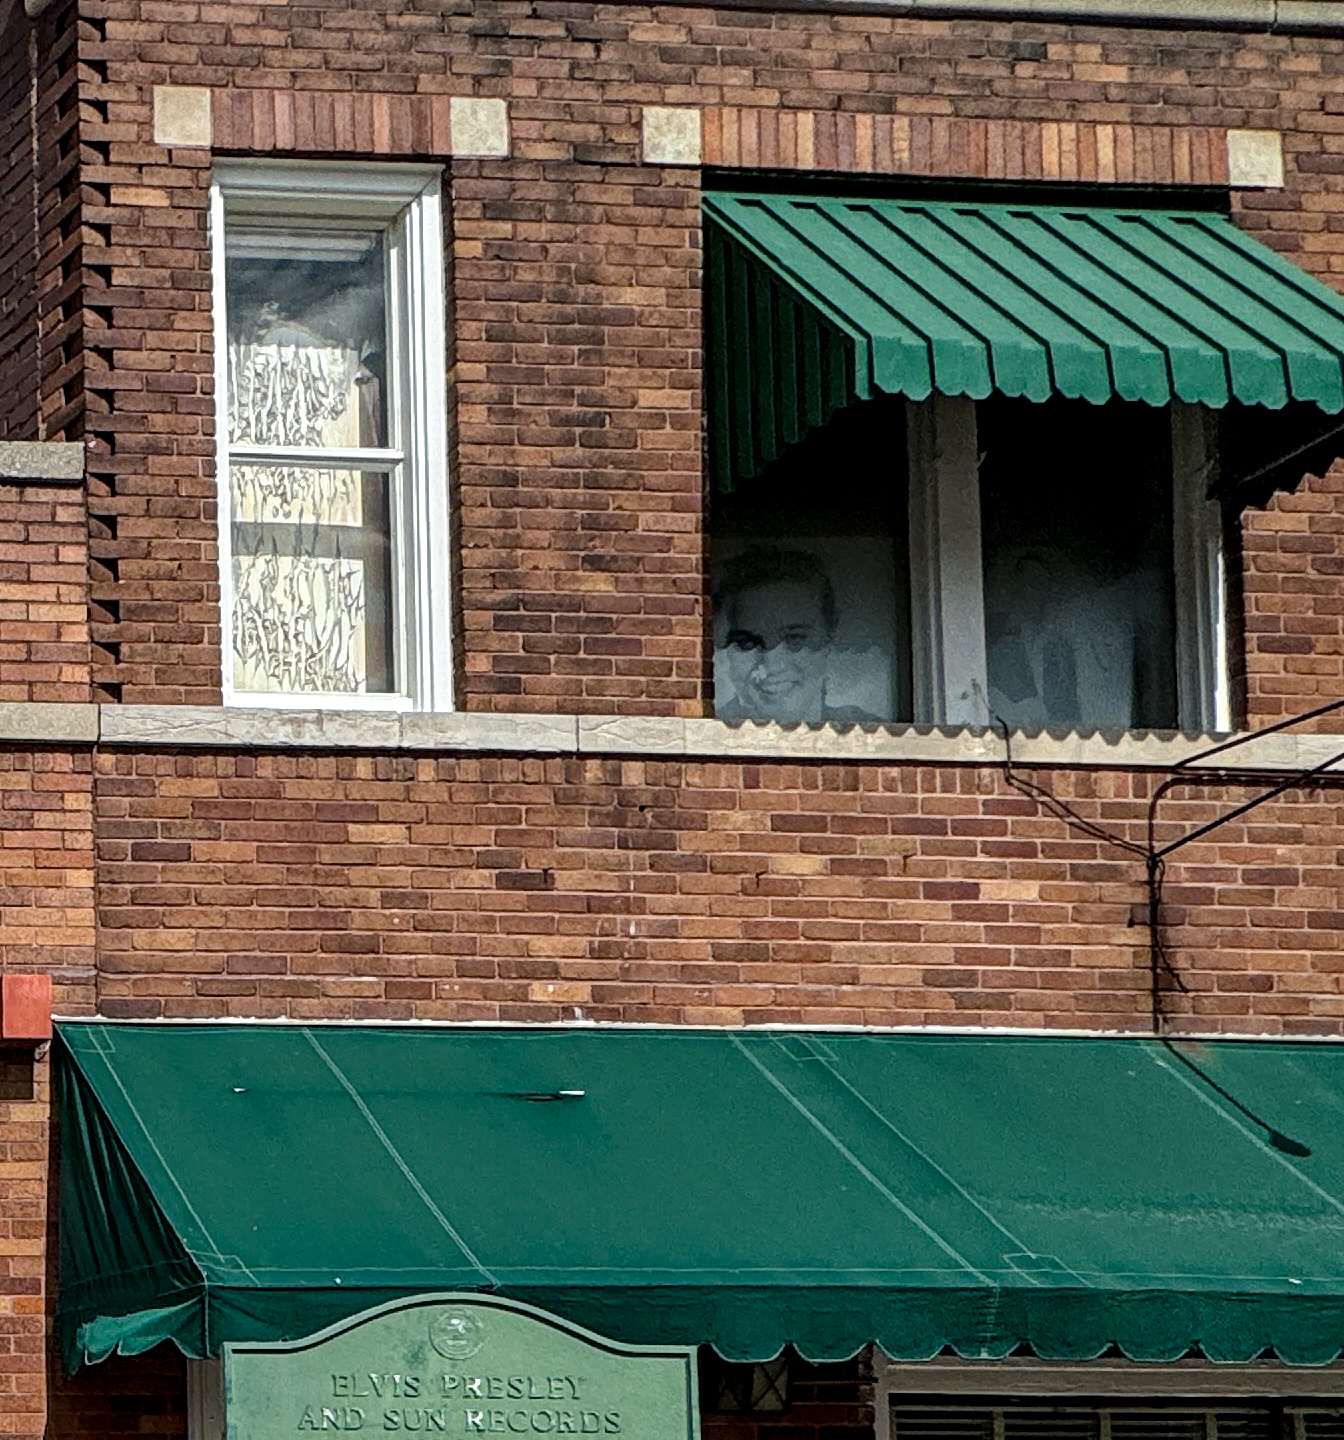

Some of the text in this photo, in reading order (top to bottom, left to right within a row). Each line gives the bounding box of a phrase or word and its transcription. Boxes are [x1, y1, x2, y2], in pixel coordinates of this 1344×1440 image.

[332, 1373, 587, 1401] ELVIS PRESLEY
[297, 1404, 622, 1434] AND SUN RECORDS
